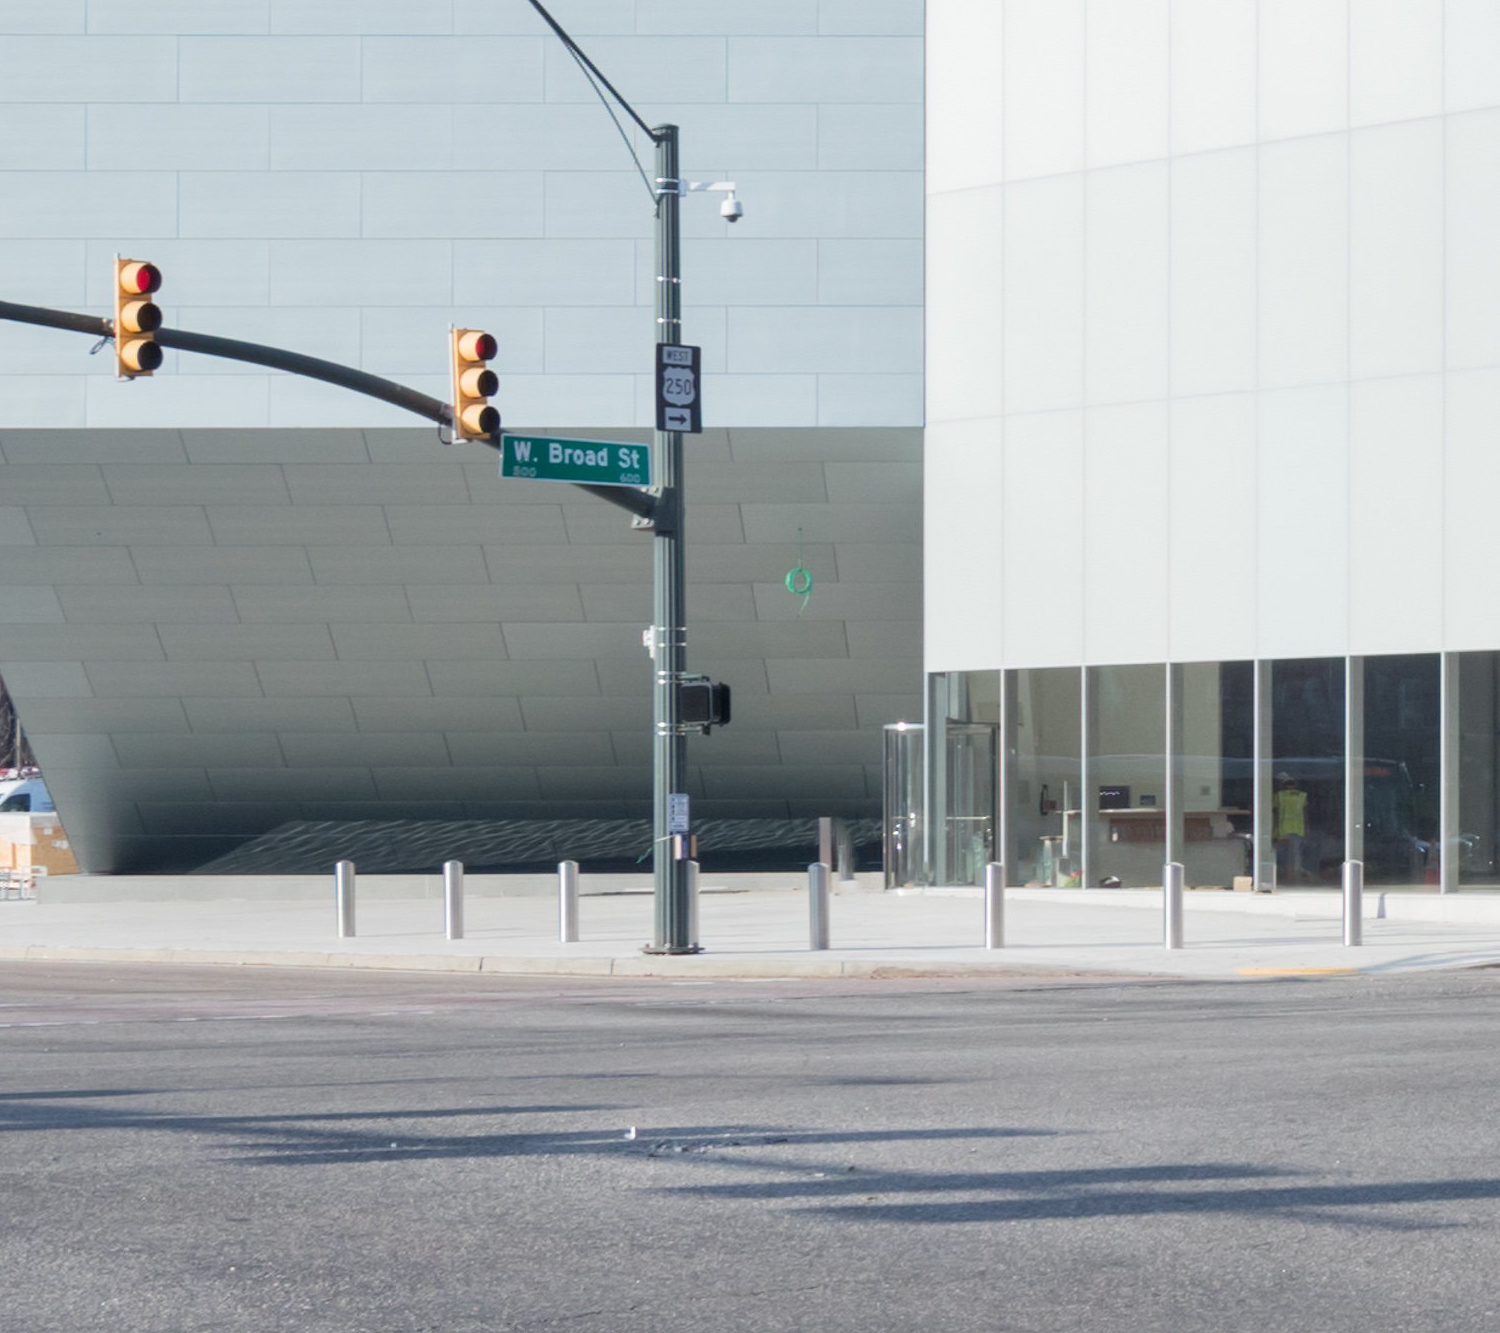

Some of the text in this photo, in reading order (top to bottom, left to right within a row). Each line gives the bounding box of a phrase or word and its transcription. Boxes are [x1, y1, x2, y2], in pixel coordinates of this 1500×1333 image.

[667, 349, 689, 362] WEST
[666, 378, 691, 395] 250
[513, 440, 640, 469] W. Broad St
[619, 472, 641, 483] 600
